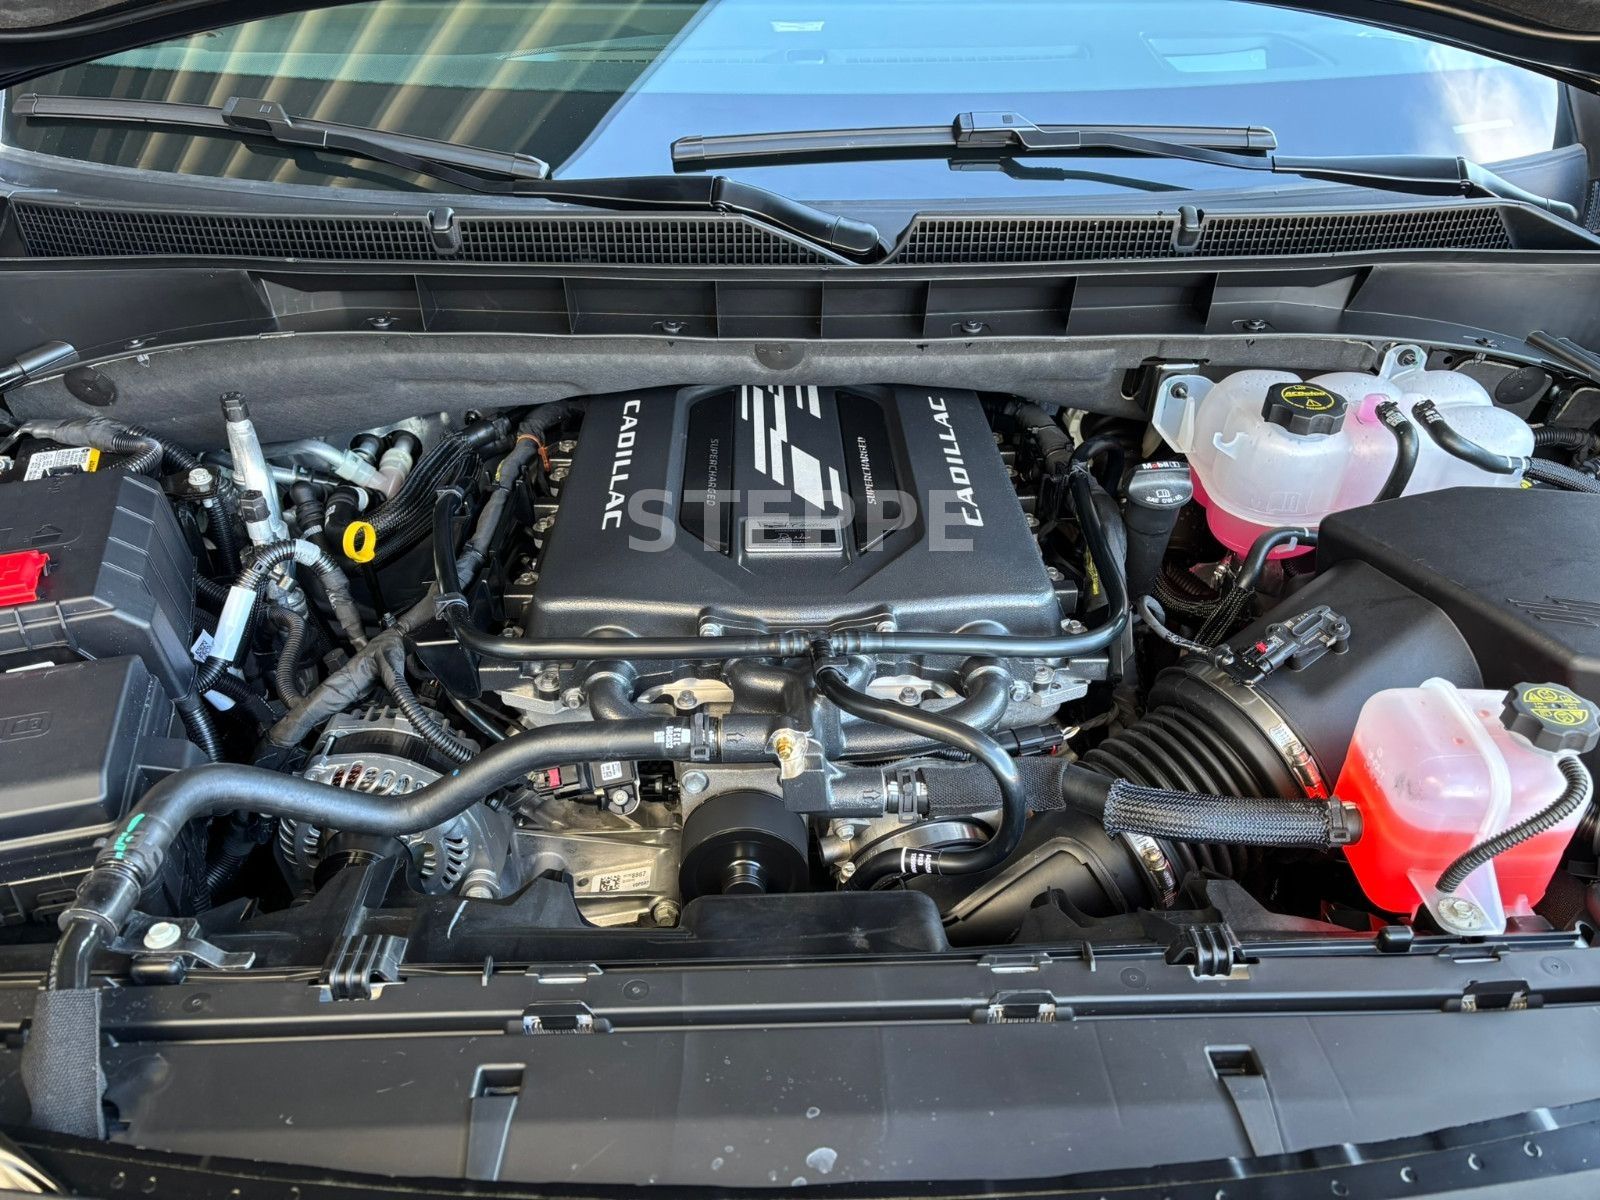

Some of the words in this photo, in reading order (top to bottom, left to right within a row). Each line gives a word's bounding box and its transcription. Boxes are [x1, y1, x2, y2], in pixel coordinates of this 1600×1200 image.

[601, 399, 641, 530] CADILLAC
[706, 438, 719, 507] SUPERCHARGED
[857, 436, 877, 505] SUPERCHARGED
[927, 396, 984, 527] CADILLAC
[1141, 461, 1169, 470] Mobil
[1145, 496, 1160, 504] SAE
